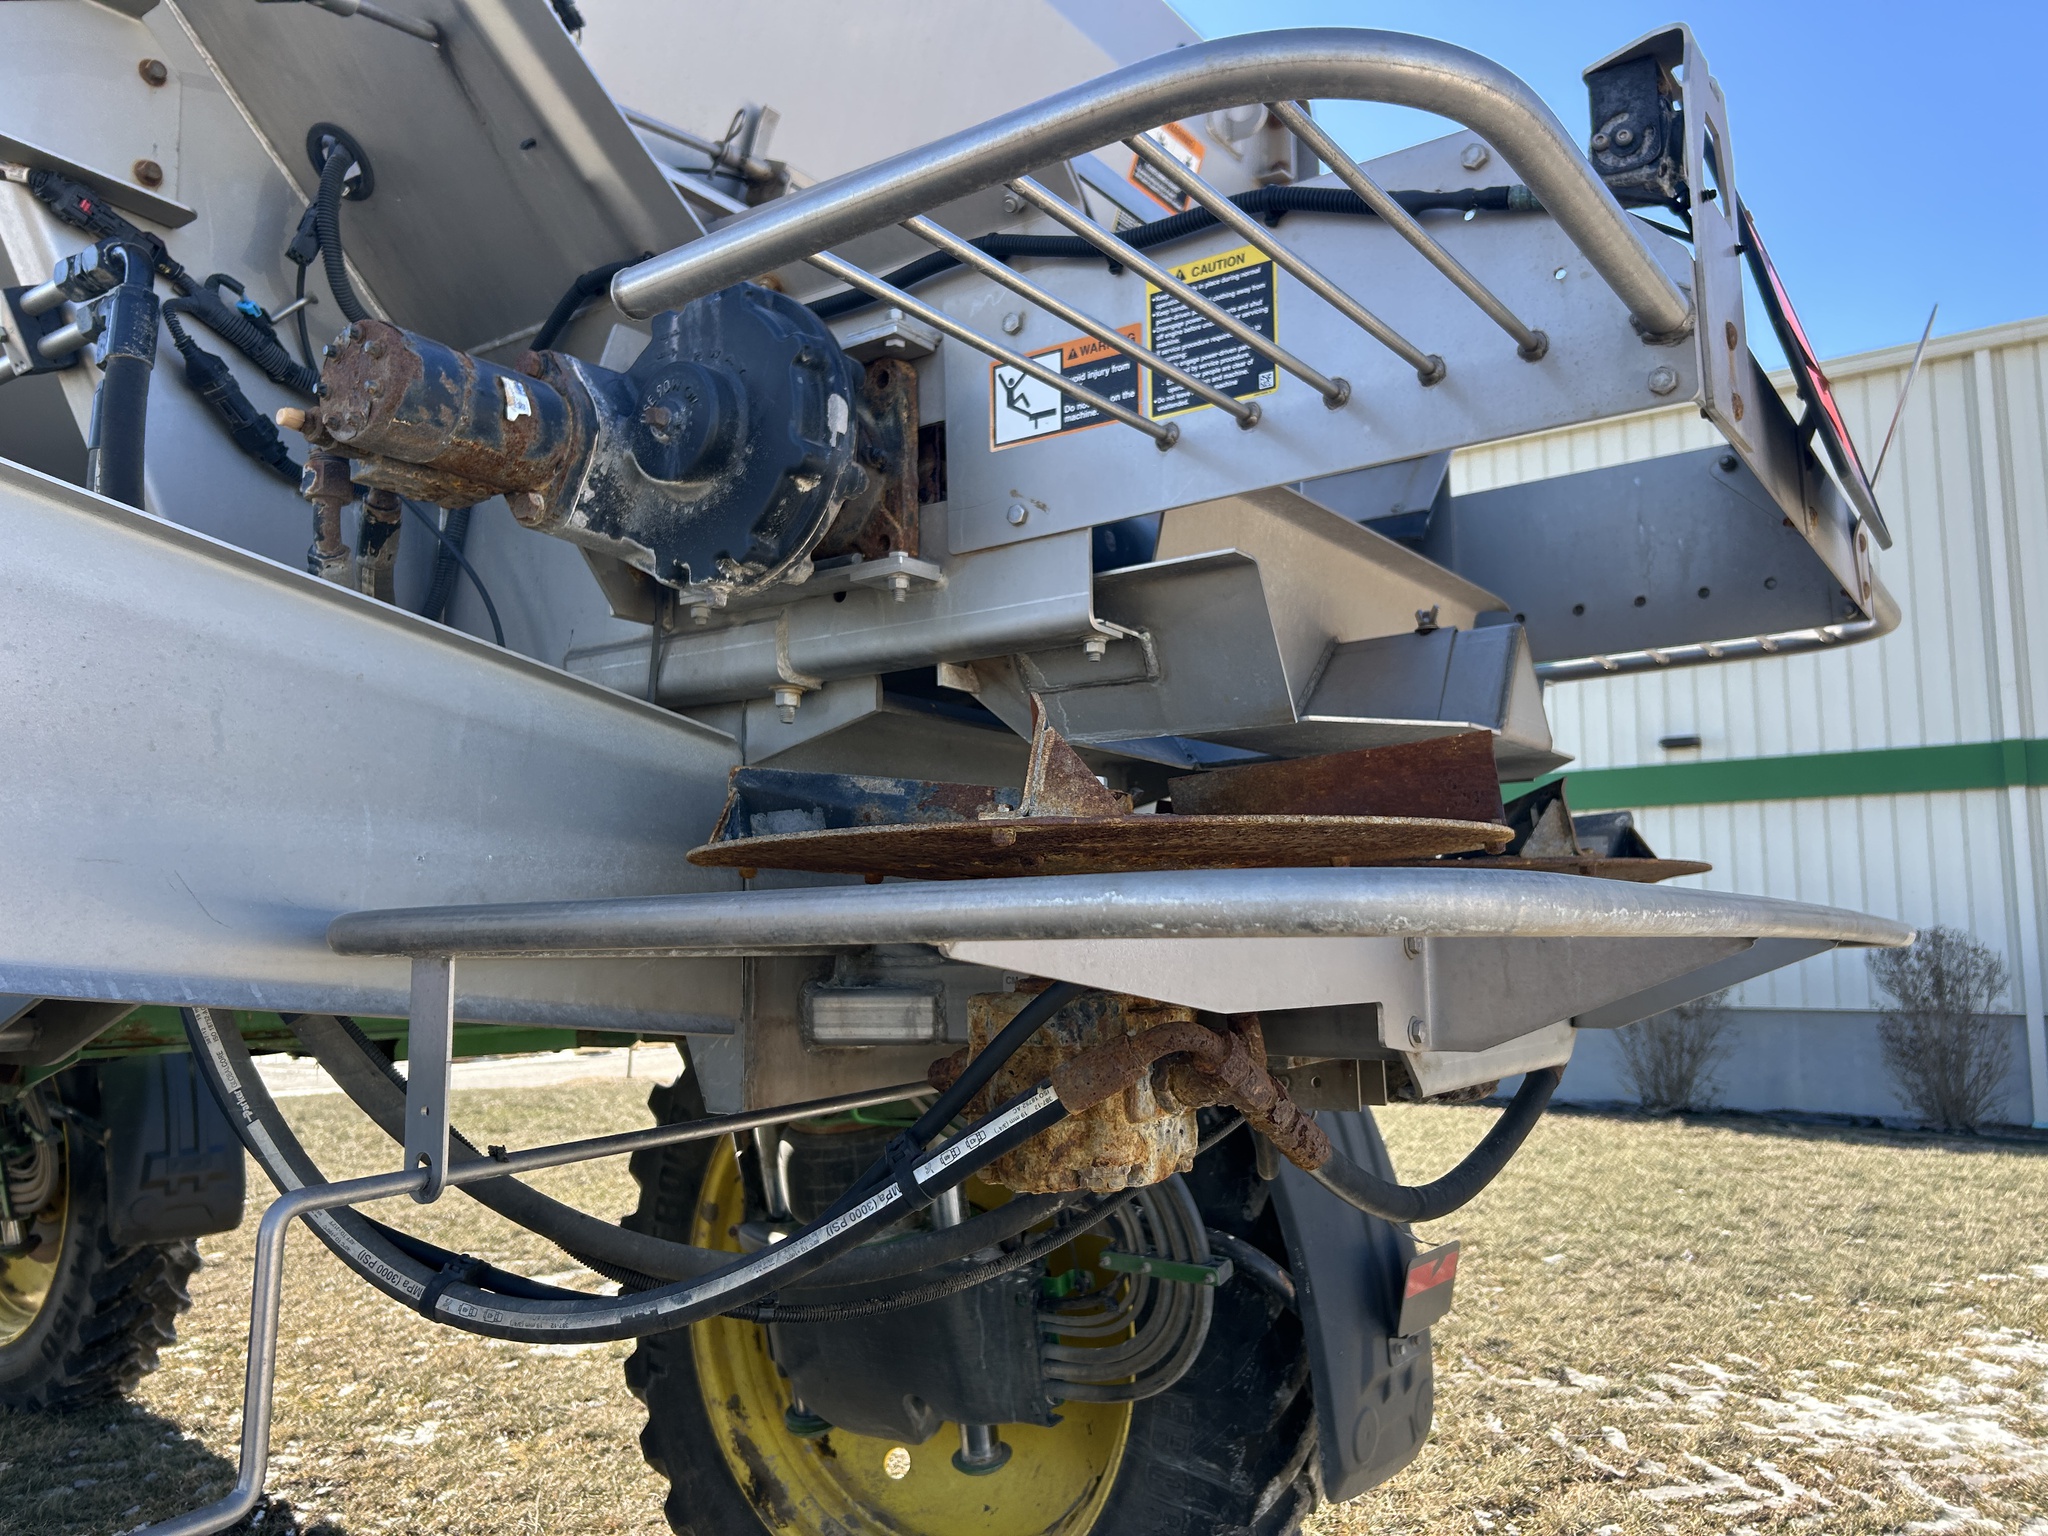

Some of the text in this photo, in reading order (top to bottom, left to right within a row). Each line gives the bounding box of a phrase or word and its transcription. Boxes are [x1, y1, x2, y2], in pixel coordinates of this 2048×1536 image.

[1191, 253, 1245, 277] CAUTION
[1204, 280, 1220, 289] place
[1221, 273, 1240, 283] during
[1240, 267, 1261, 278] normal
[1212, 291, 1236, 302] clothing
[1236, 287, 1251, 296] away
[1251, 282, 1266, 291] from
[1237, 303, 1249, 311] and
[1164, 329, 1183, 339] engine
[1183, 325, 1201, 334] before
[1241, 307, 1269, 319] servicing
[1161, 346, 1181, 355] service
[1181, 339, 1210, 351] procedure
[1179, 357, 1200, 367] engage
[1200, 348, 1237, 362] power-driven
[1199, 360, 1219, 369] service
[1087, 367, 1110, 380] injury
[1111, 362, 1130, 373] from
[1201, 368, 1221, 378] people
[1232, 361, 1246, 369] clear
[1247, 358, 1254, 366] of
[1211, 375, 1223, 383] and
[1176, 391, 1190, 399] leave
[1213, 380, 1238, 390] machine
[1064, 404, 1075, 413] Do
[1110, 394, 1120, 402] on
[1122, 390, 1135, 400] the
[1064, 408, 1100, 423] machine.
[211, 1032, 219, 1042] ISO
[216, 1050, 238, 1088] GLOBALCORE
[1038, 1089, 1050, 1099] ISO
[234, 1090, 253, 1119] Parker
[826, 1184, 900, 1236] MPa (3000 PSI)
[357, 1249, 424, 1298] MPa (3000 PSI)
